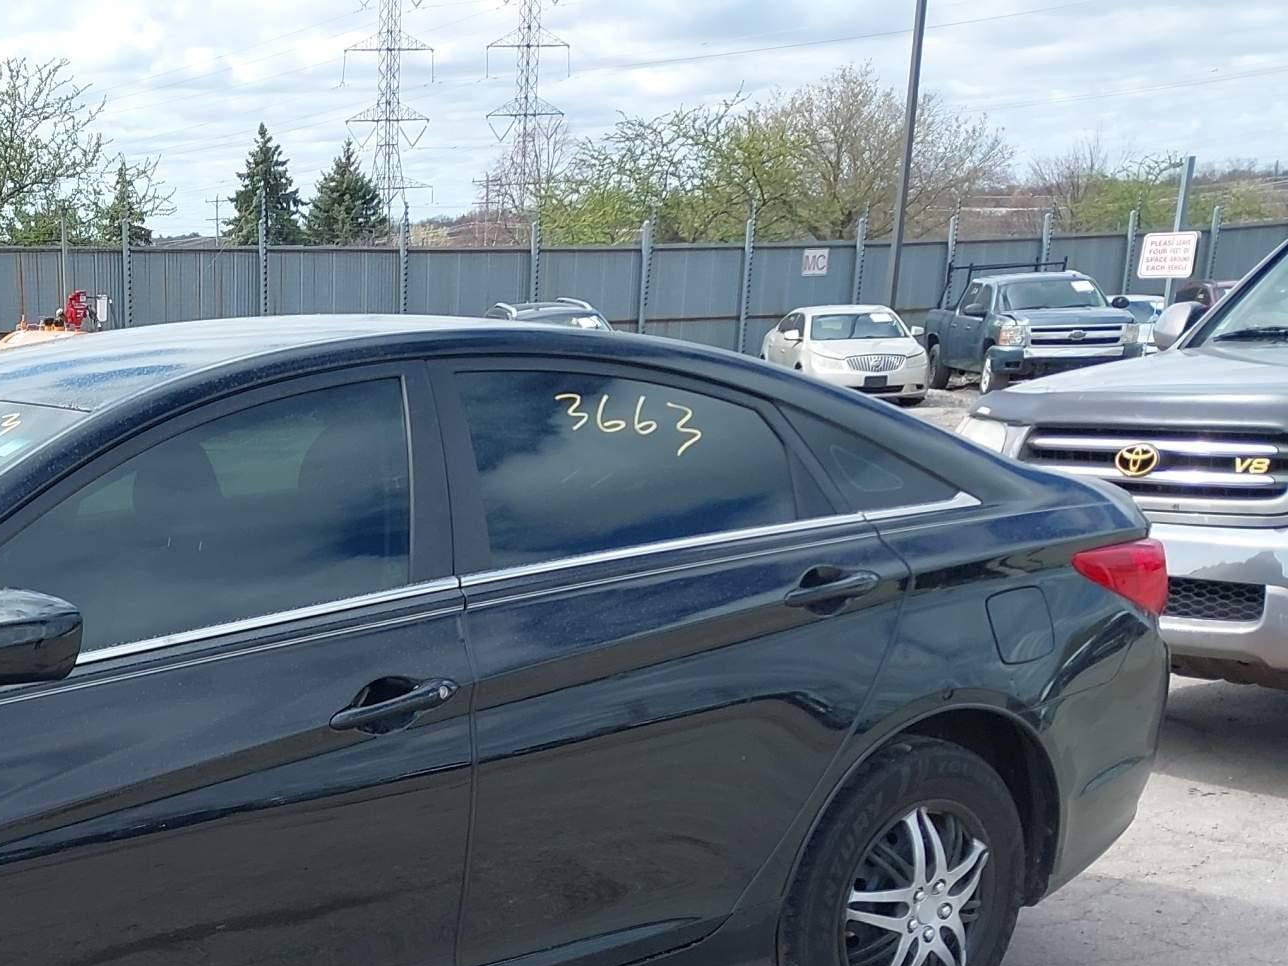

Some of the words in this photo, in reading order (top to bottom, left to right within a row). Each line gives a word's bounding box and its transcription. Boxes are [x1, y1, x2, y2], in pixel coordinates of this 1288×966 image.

[804, 254, 826, 271] MC
[554, 393, 702, 456] 3663
[1235, 457, 1271, 474] V8
